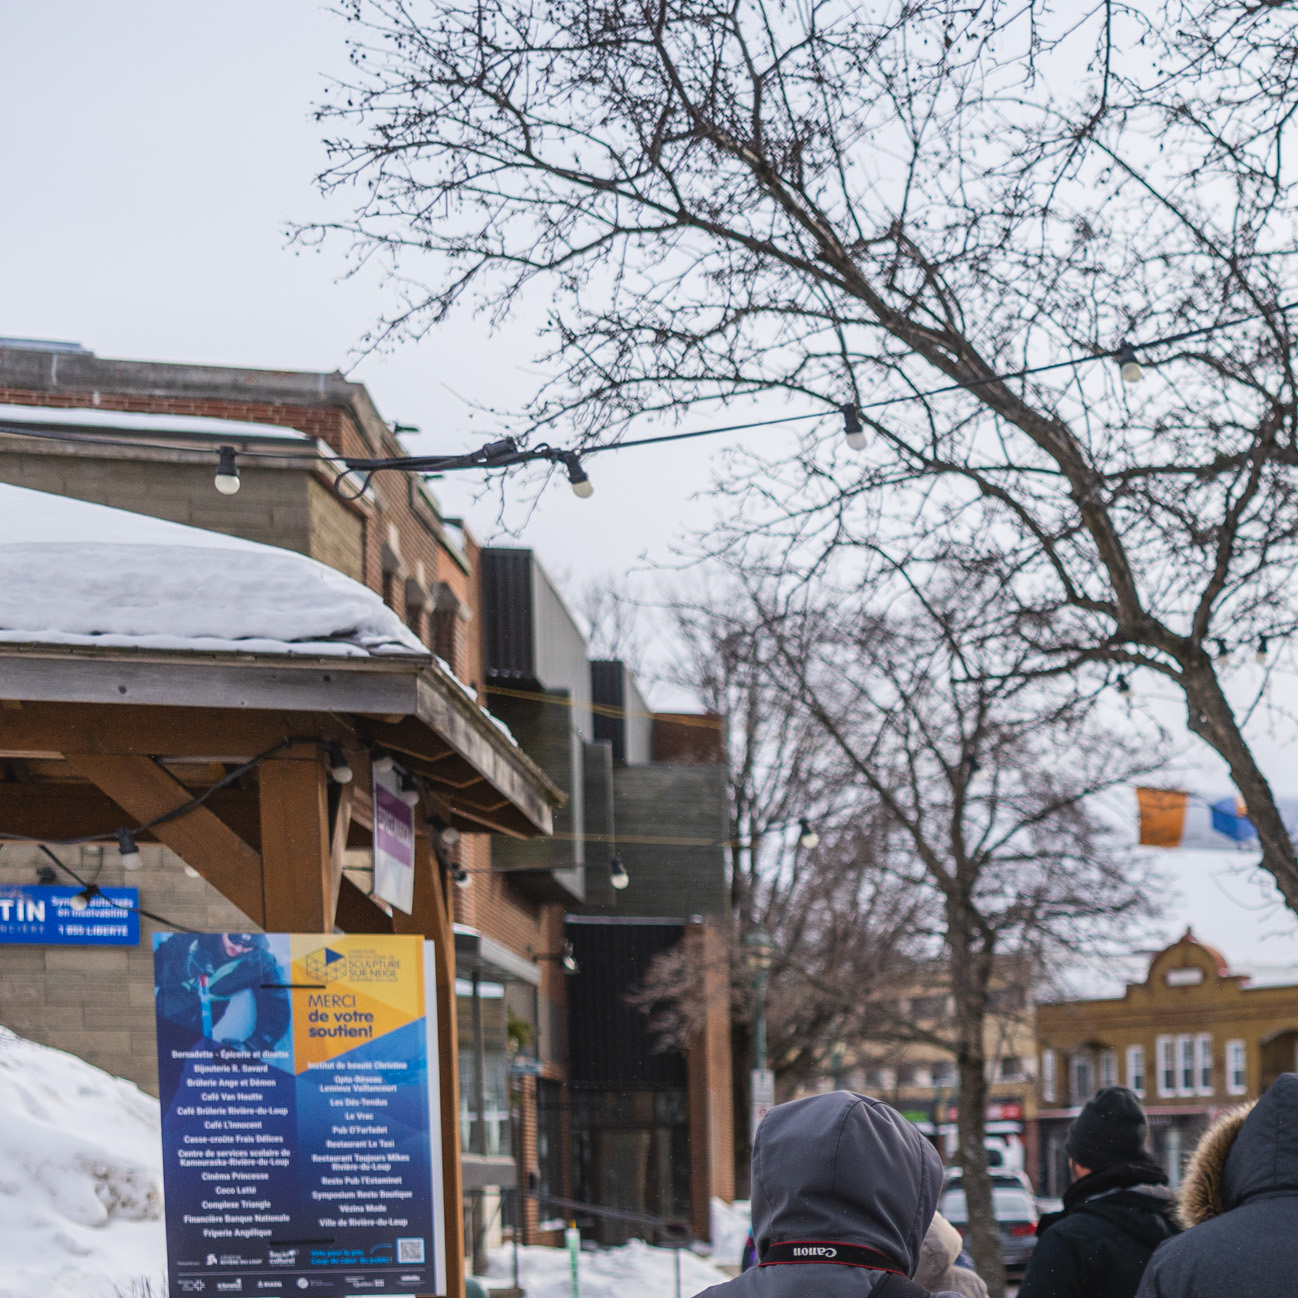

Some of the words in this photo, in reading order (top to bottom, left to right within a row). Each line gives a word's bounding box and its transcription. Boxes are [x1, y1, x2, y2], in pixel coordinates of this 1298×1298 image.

[348, 960, 400, 969] SCULPTURE
[349, 970, 368, 978] SUR
[370, 970, 396, 978] NEIGE
[308, 994, 356, 1008] MERCI
[308, 1009, 329, 1022] de
[334, 1009, 374, 1022] votre
[309, 1024, 373, 1037] soutien!
[172, 1050, 213, 1059] Bernadette
[221, 1049, 250, 1060] Épicerie
[253, 1050, 260, 1059] et
[194, 1064, 230, 1074] Bijouterie
[242, 1064, 268, 1073] Savard
[187, 1078, 217, 1087] Brûlerie
[219, 1079, 238, 1088] Ange
[250, 1078, 276, 1087] Démon
[202, 1092, 219, 1101] Café
[221, 1092, 236, 1101] Van
[237, 1092, 263, 1101] Houtte
[330, 1098, 343, 1106] Les
[177, 1107, 195, 1115] Café
[196, 1107, 226, 1115] Brûlerie
[228, 1107, 288, 1116] Rivière-du-Loup
[345, 1112, 355, 1120] Le
[204, 1121, 222, 1129] Café
[332, 1126, 347, 1134] Pub
[184, 1134, 234, 1144] Casse-croûte
[236, 1134, 254, 1144] Frais
[256, 1134, 283, 1144] Délices
[326, 1139, 367, 1148] Restaurant
[368, 1139, 378, 1148] Le
[178, 1149, 204, 1158] Centre
[205, 1149, 215, 1158] de
[217, 1149, 248, 1158] services
[250, 1149, 279, 1158] scolaire
[281, 1149, 290, 1158] de
[312, 1153, 352, 1162] Restaurant
[354, 1153, 386, 1163] Toujours
[387, 1153, 410, 1162] Mikes
[180, 1158, 289, 1167] Kamouraska-Rivière-du-Loup
[332, 1163, 391, 1172] Rivière-du-Loup
[202, 1172, 230, 1181] Cinéma
[232, 1172, 269, 1181] Princesse
[322, 1176, 343, 1185] Resto
[344, 1176, 359, 1185] Pub
[215, 1186, 235, 1194] Coco
[312, 1191, 355, 1200] Symposium
[357, 1190, 378, 1199] Resto
[380, 1190, 412, 1200] Boutique
[202, 1200, 239, 1210] Complexe
[241, 1200, 271, 1210] Triangle
[366, 1204, 387, 1213] Mode
[184, 1214, 223, 1223] Financière
[224, 1214, 253, 1224] Banque
[254, 1214, 290, 1222] Nationale
[319, 1218, 336, 1227] Ville
[338, 1218, 347, 1227] de
[349, 1218, 408, 1227] Rivière-du-Loup
[203, 1228, 232, 1238] Friperie
[234, 1228, 272, 1238] Angélique
[793, 1247, 837, 1258] Canon
